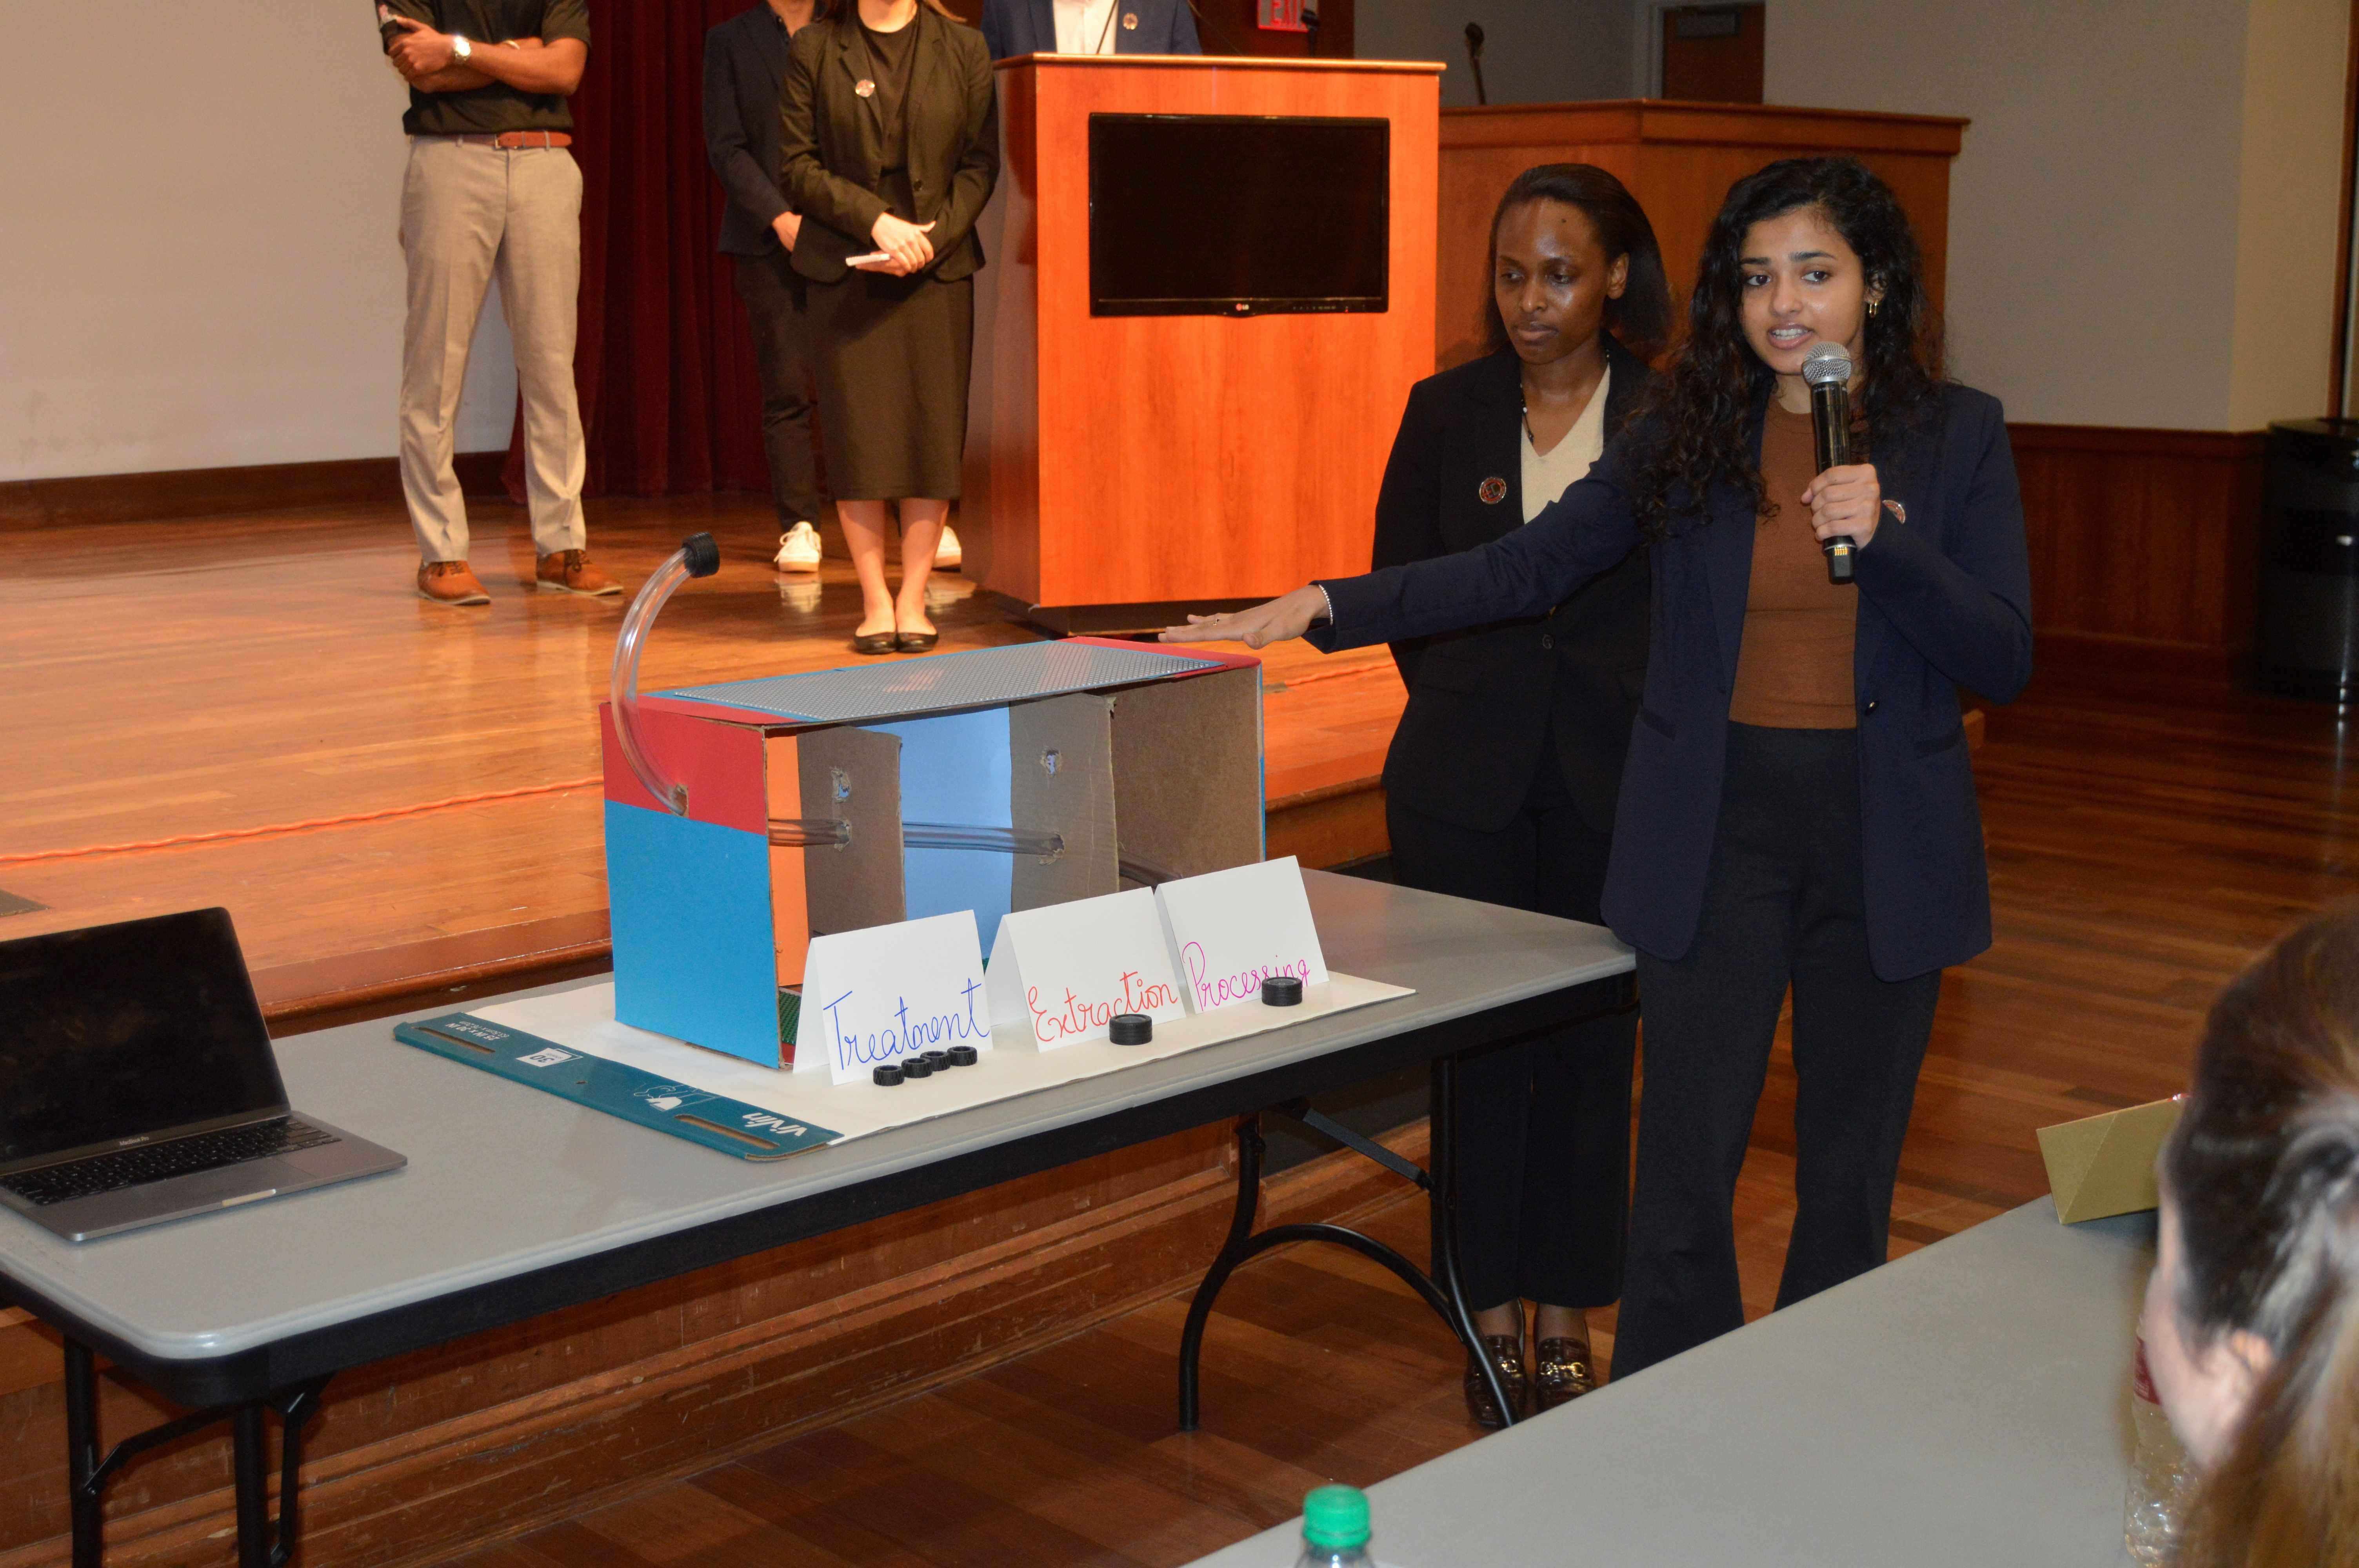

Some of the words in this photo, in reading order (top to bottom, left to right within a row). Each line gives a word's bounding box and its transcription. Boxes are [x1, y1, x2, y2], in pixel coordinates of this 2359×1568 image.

[1182, 942, 1310, 1011] Processing
[823, 977, 990, 1070] Treatment
[1028, 971, 1178, 1042] Extraction
[530, 1054, 554, 1063] 30
[119, 1138, 141, 1146] MacBook
[742, 1112, 807, 1136] vivin
